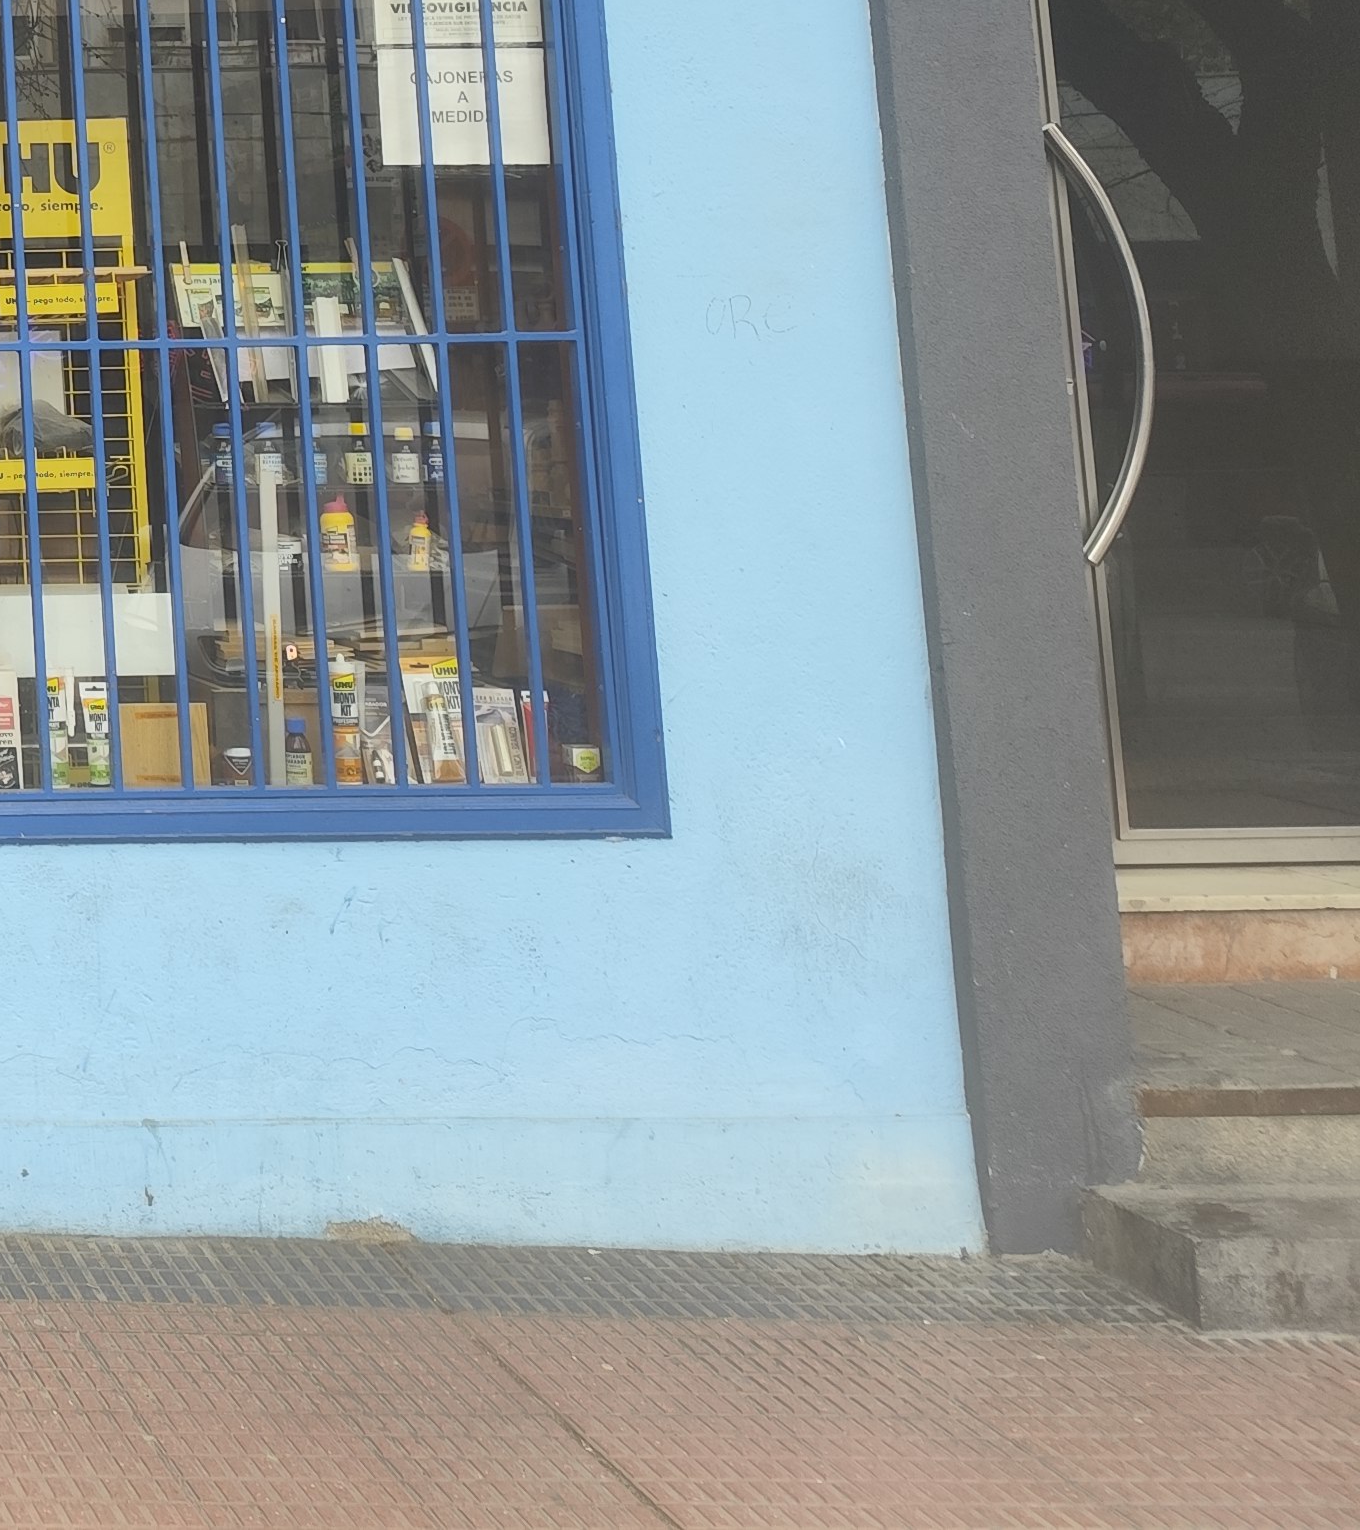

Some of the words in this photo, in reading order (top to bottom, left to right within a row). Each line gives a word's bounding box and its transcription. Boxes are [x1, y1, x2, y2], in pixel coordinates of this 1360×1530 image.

[390, 2, 528, 14] VIEOVIGILNCIA
[457, 91, 469, 104] A
[432, 110, 489, 123] MEDID
[40, 199, 104, 214] siempe.
[56, 296, 77, 304] todo,
[79, 296, 114, 304] sipre.
[35, 471, 57, 479] odo,
[59, 470, 94, 478] siempre.
[435, 666, 458, 676] UHU
[334, 681, 353, 689] UHU
[438, 680, 461, 696] MONT
[446, 695, 461, 710] KIT
[340, 704, 352, 717] KIT
